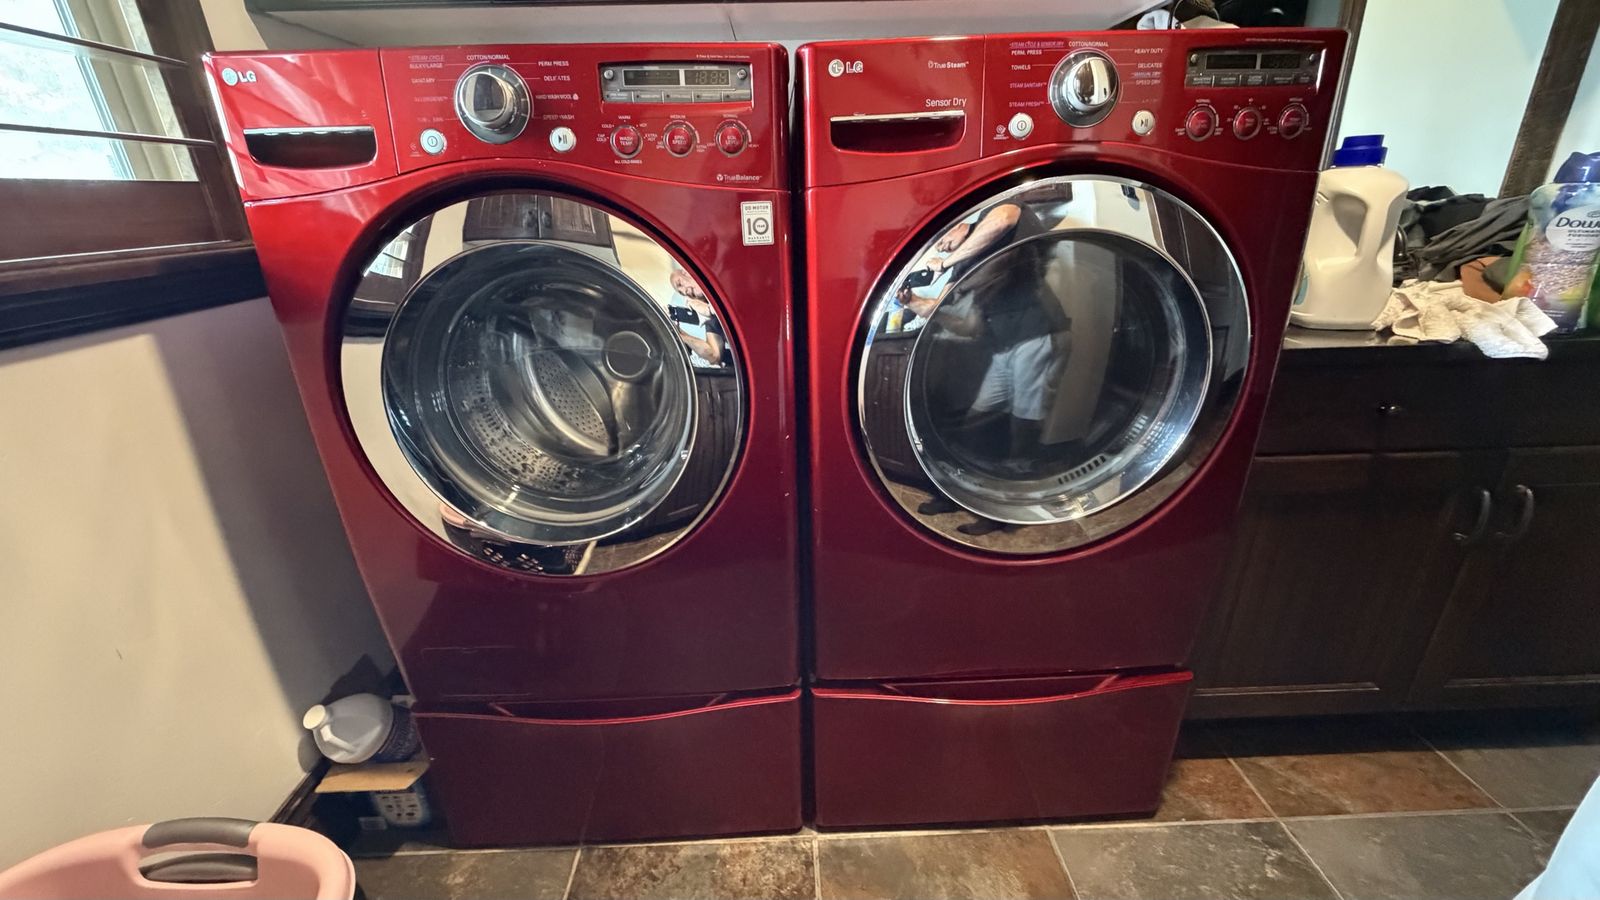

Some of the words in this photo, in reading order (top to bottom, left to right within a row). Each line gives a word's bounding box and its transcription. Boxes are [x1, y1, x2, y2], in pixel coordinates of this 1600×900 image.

[846, 60, 863, 73] LG
[238, 69, 257, 83] LG
[925, 98, 951, 108] Sensor
[952, 97, 967, 108] Dry
[746, 217, 769, 235] 10
